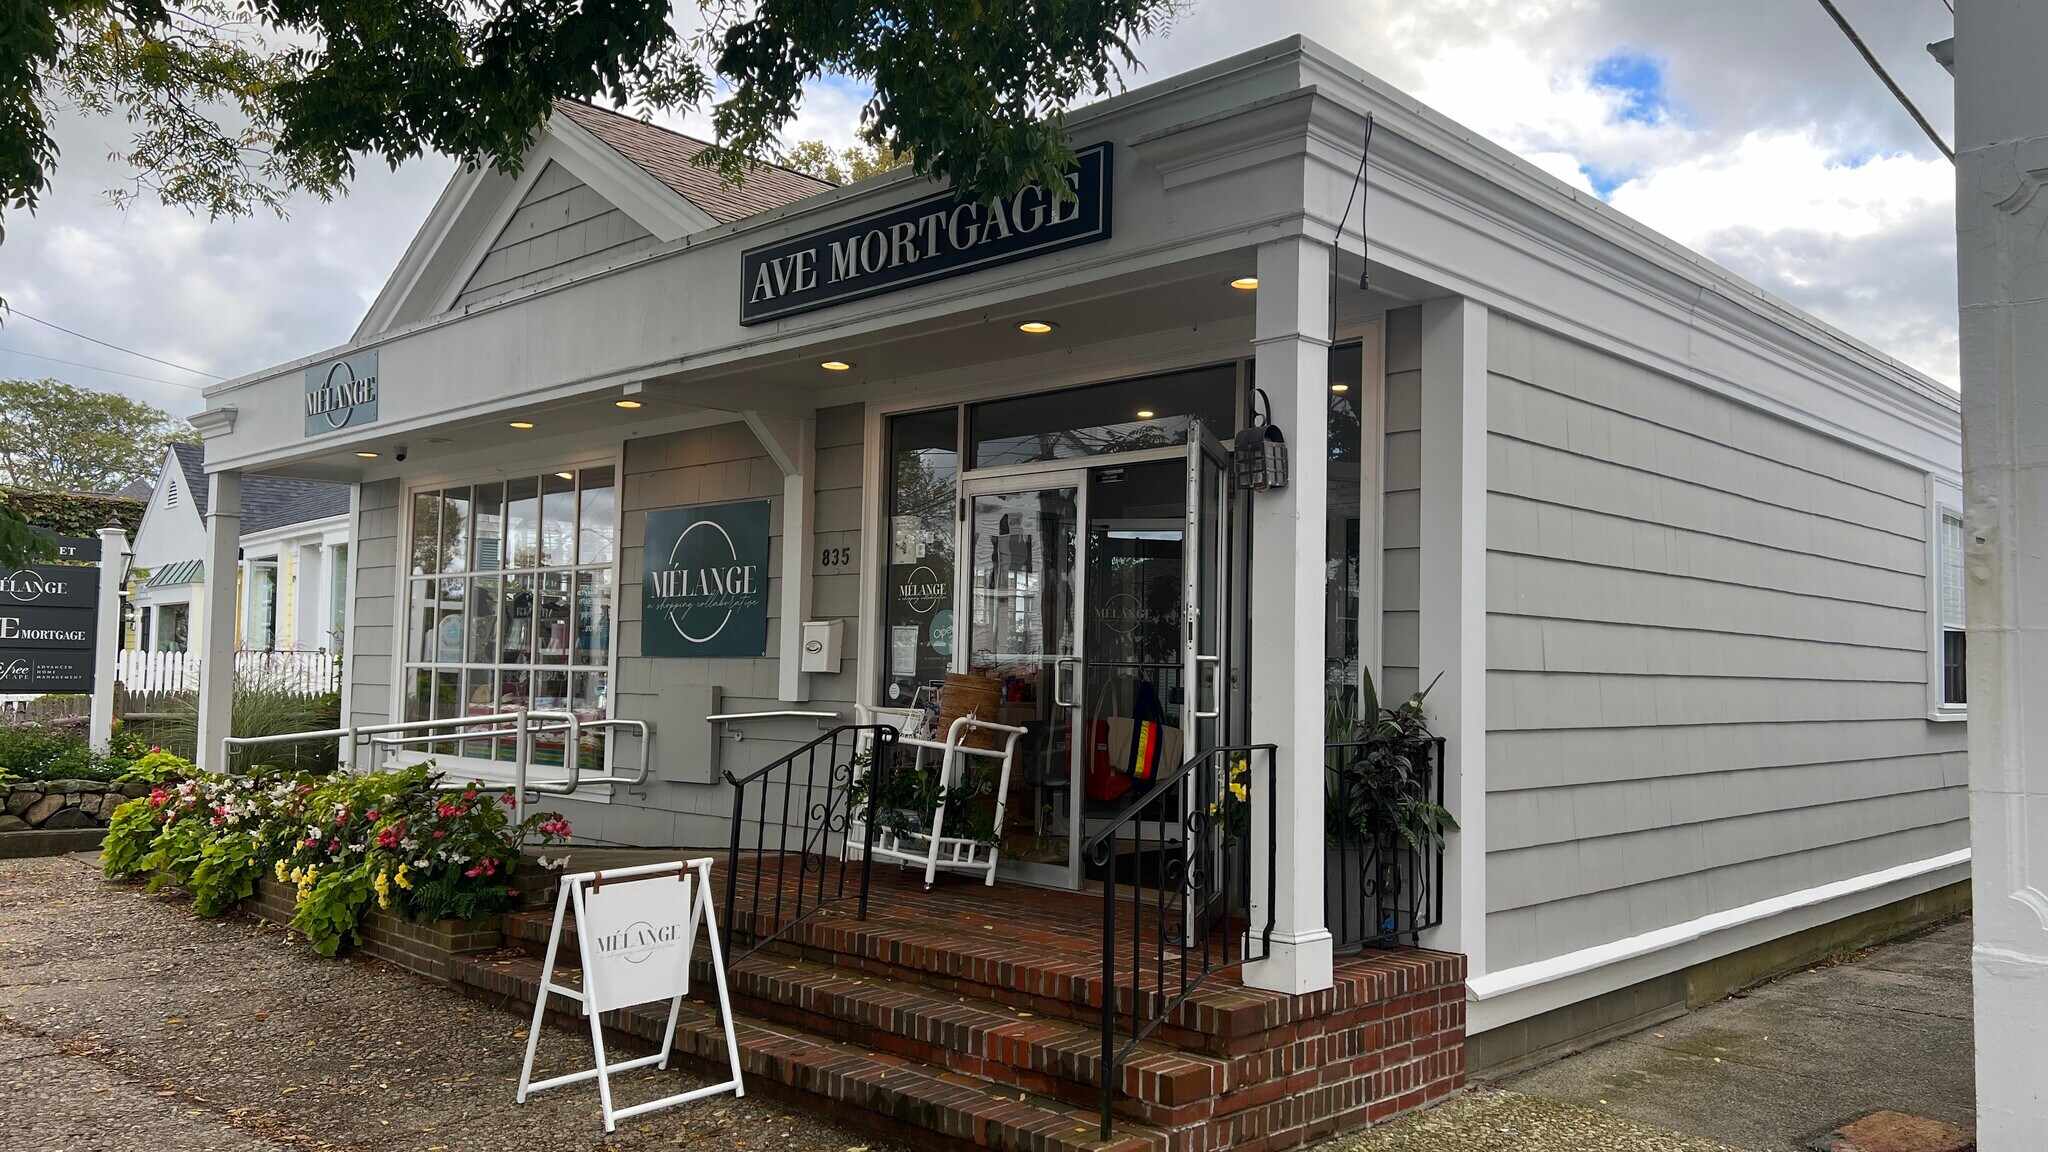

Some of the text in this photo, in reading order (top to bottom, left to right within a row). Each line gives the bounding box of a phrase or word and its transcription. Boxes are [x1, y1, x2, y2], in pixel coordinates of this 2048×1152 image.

[749, 172, 1080, 304] AVE MORTGAGE
[306, 377, 375, 416] MÉLANGE
[821, 547, 850, 566] 835
[0, 577, 68, 595] ÉLANGE
[650, 562, 757, 598] MÉLANGE
[899, 582, 947, 597] MÉLANGE
[656, 597, 694, 620] shopping
[697, 589, 759, 613] collaborative
[21, 629, 86, 641] MORTGAGE
[933, 626, 953, 642] Ope
[596, 924, 680, 953] MÉLANGE
